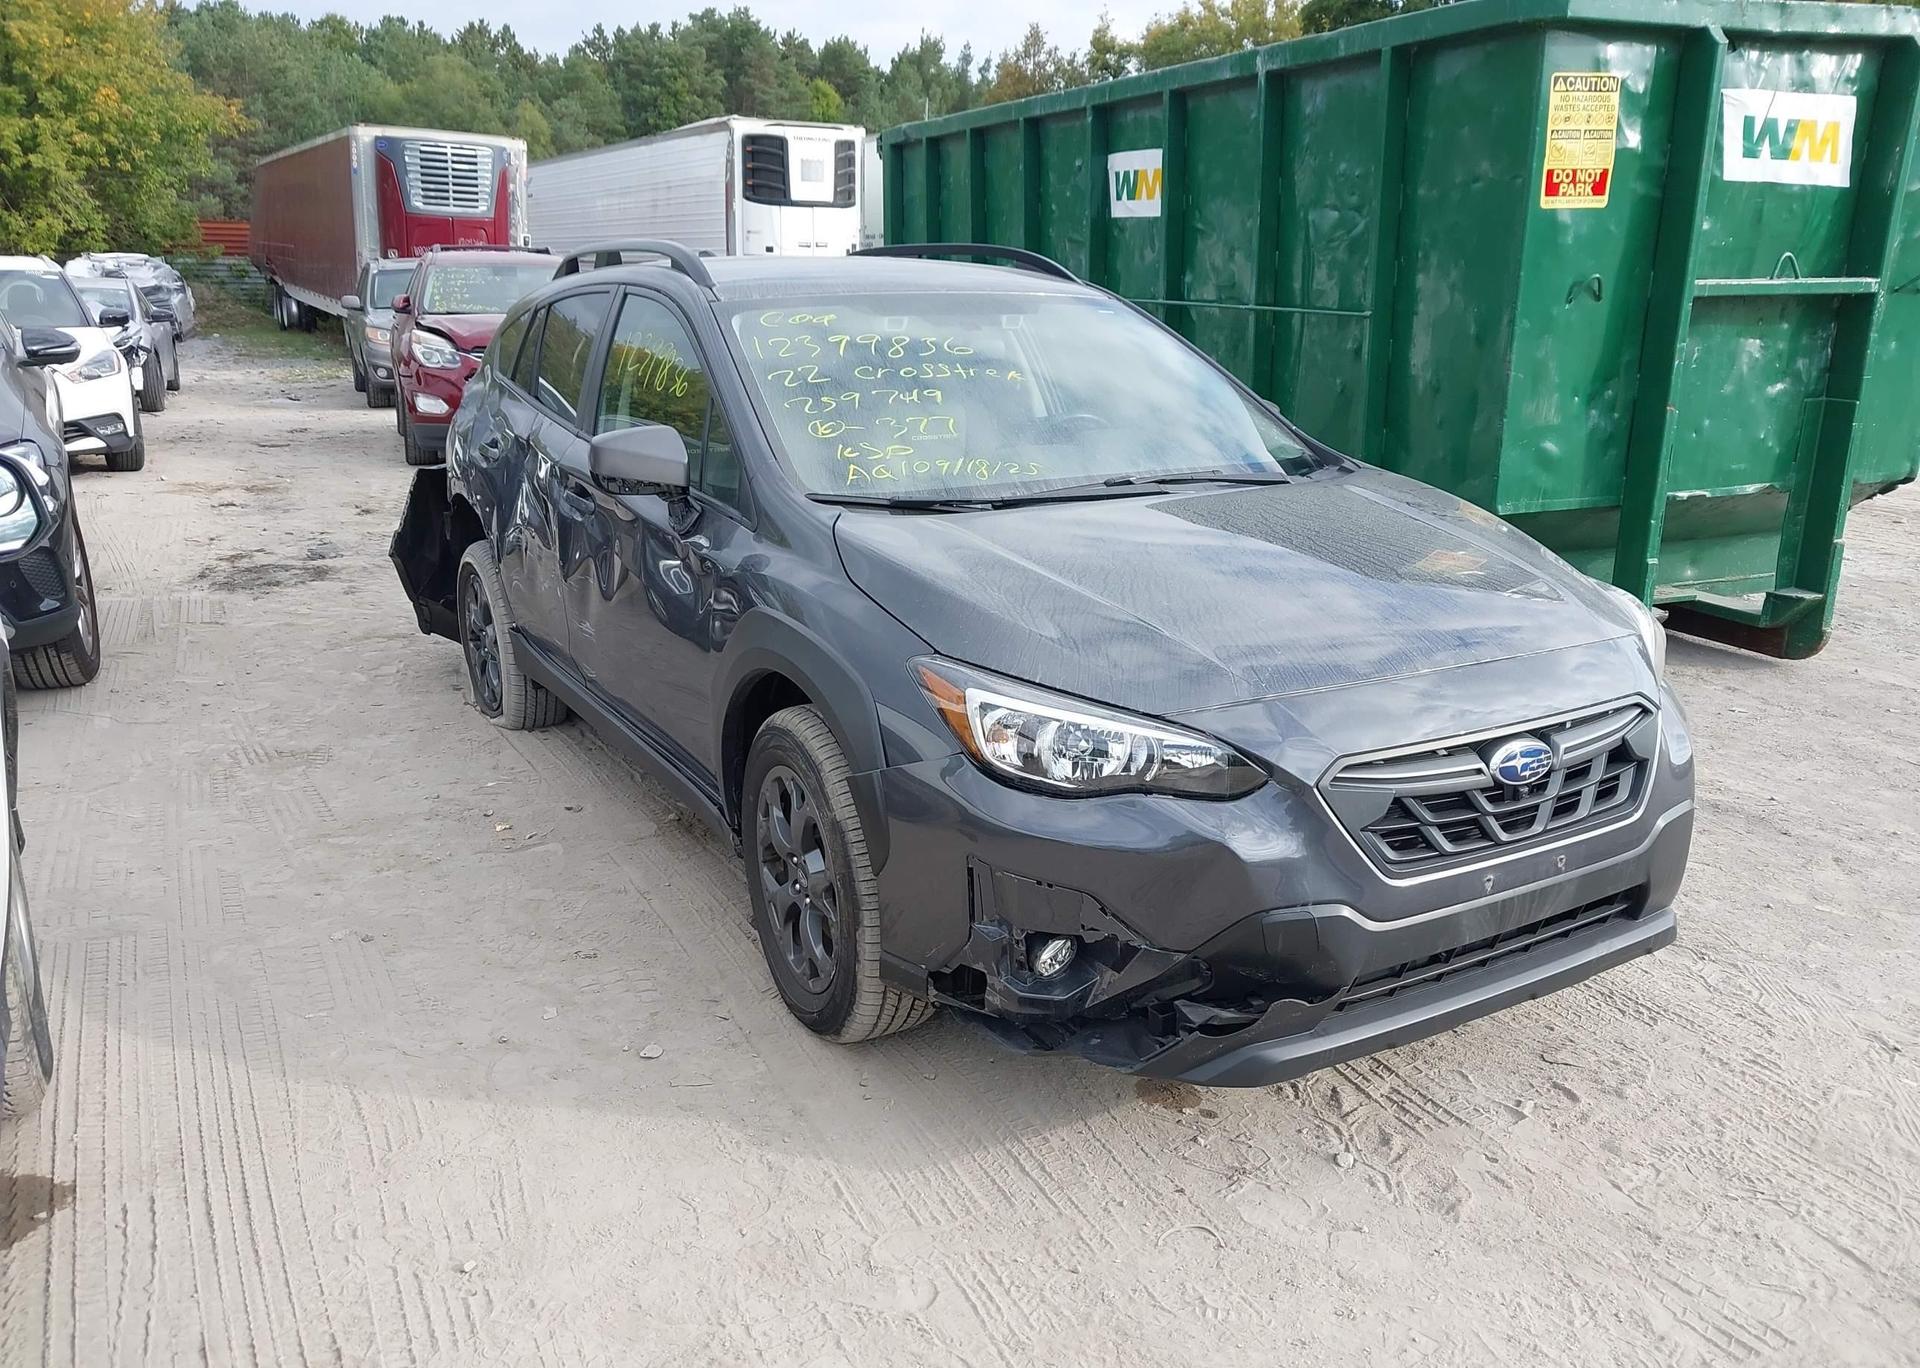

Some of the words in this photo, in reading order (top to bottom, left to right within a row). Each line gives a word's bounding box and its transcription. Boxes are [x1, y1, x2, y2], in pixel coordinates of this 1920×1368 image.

[1566, 77, 1618, 92] CAUTION
[1560, 94, 1571, 103] NO
[1572, 94, 1611, 103] HAZARDOUS
[1554, 104, 1580, 112] WASTES
[1582, 104, 1615, 112] ACCEPTED
[1741, 115, 1841, 164] WM
[1553, 169, 1573, 183] DO
[1576, 168, 1603, 183] NOT
[1115, 168, 1162, 201] WM
[1559, 182, 1594, 196] PARK
[753, 333, 974, 359] 12399836
[768, 365, 831, 387] 22
